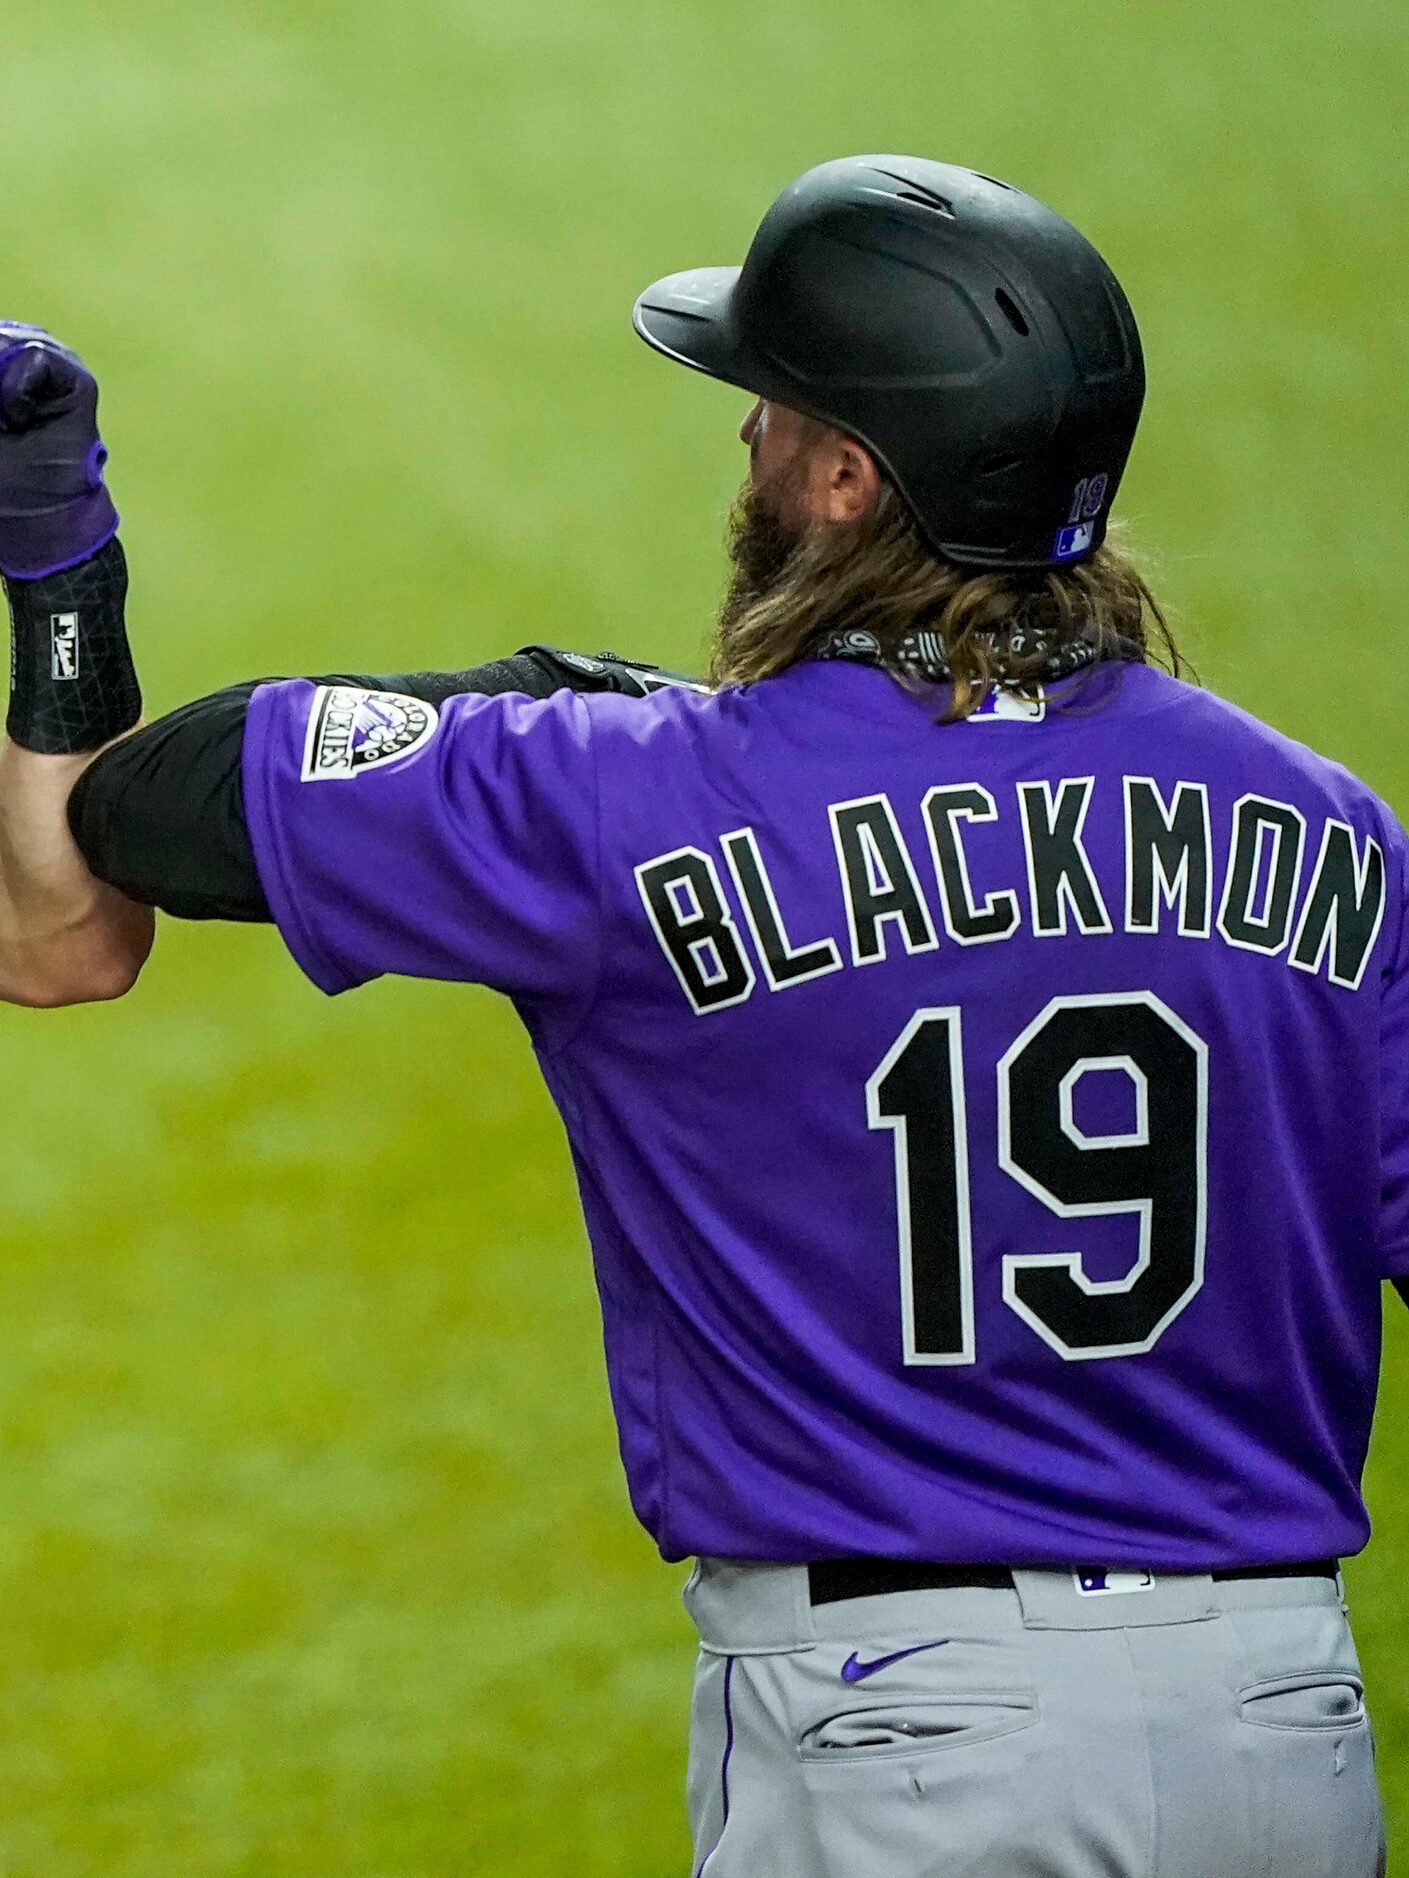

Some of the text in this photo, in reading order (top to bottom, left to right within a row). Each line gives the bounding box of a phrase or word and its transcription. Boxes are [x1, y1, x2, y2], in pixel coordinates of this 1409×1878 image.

[1068, 472, 1108, 523] 19
[633, 775, 1387, 1016] BLACKMON
[865, 990, 1209, 1366] 19
